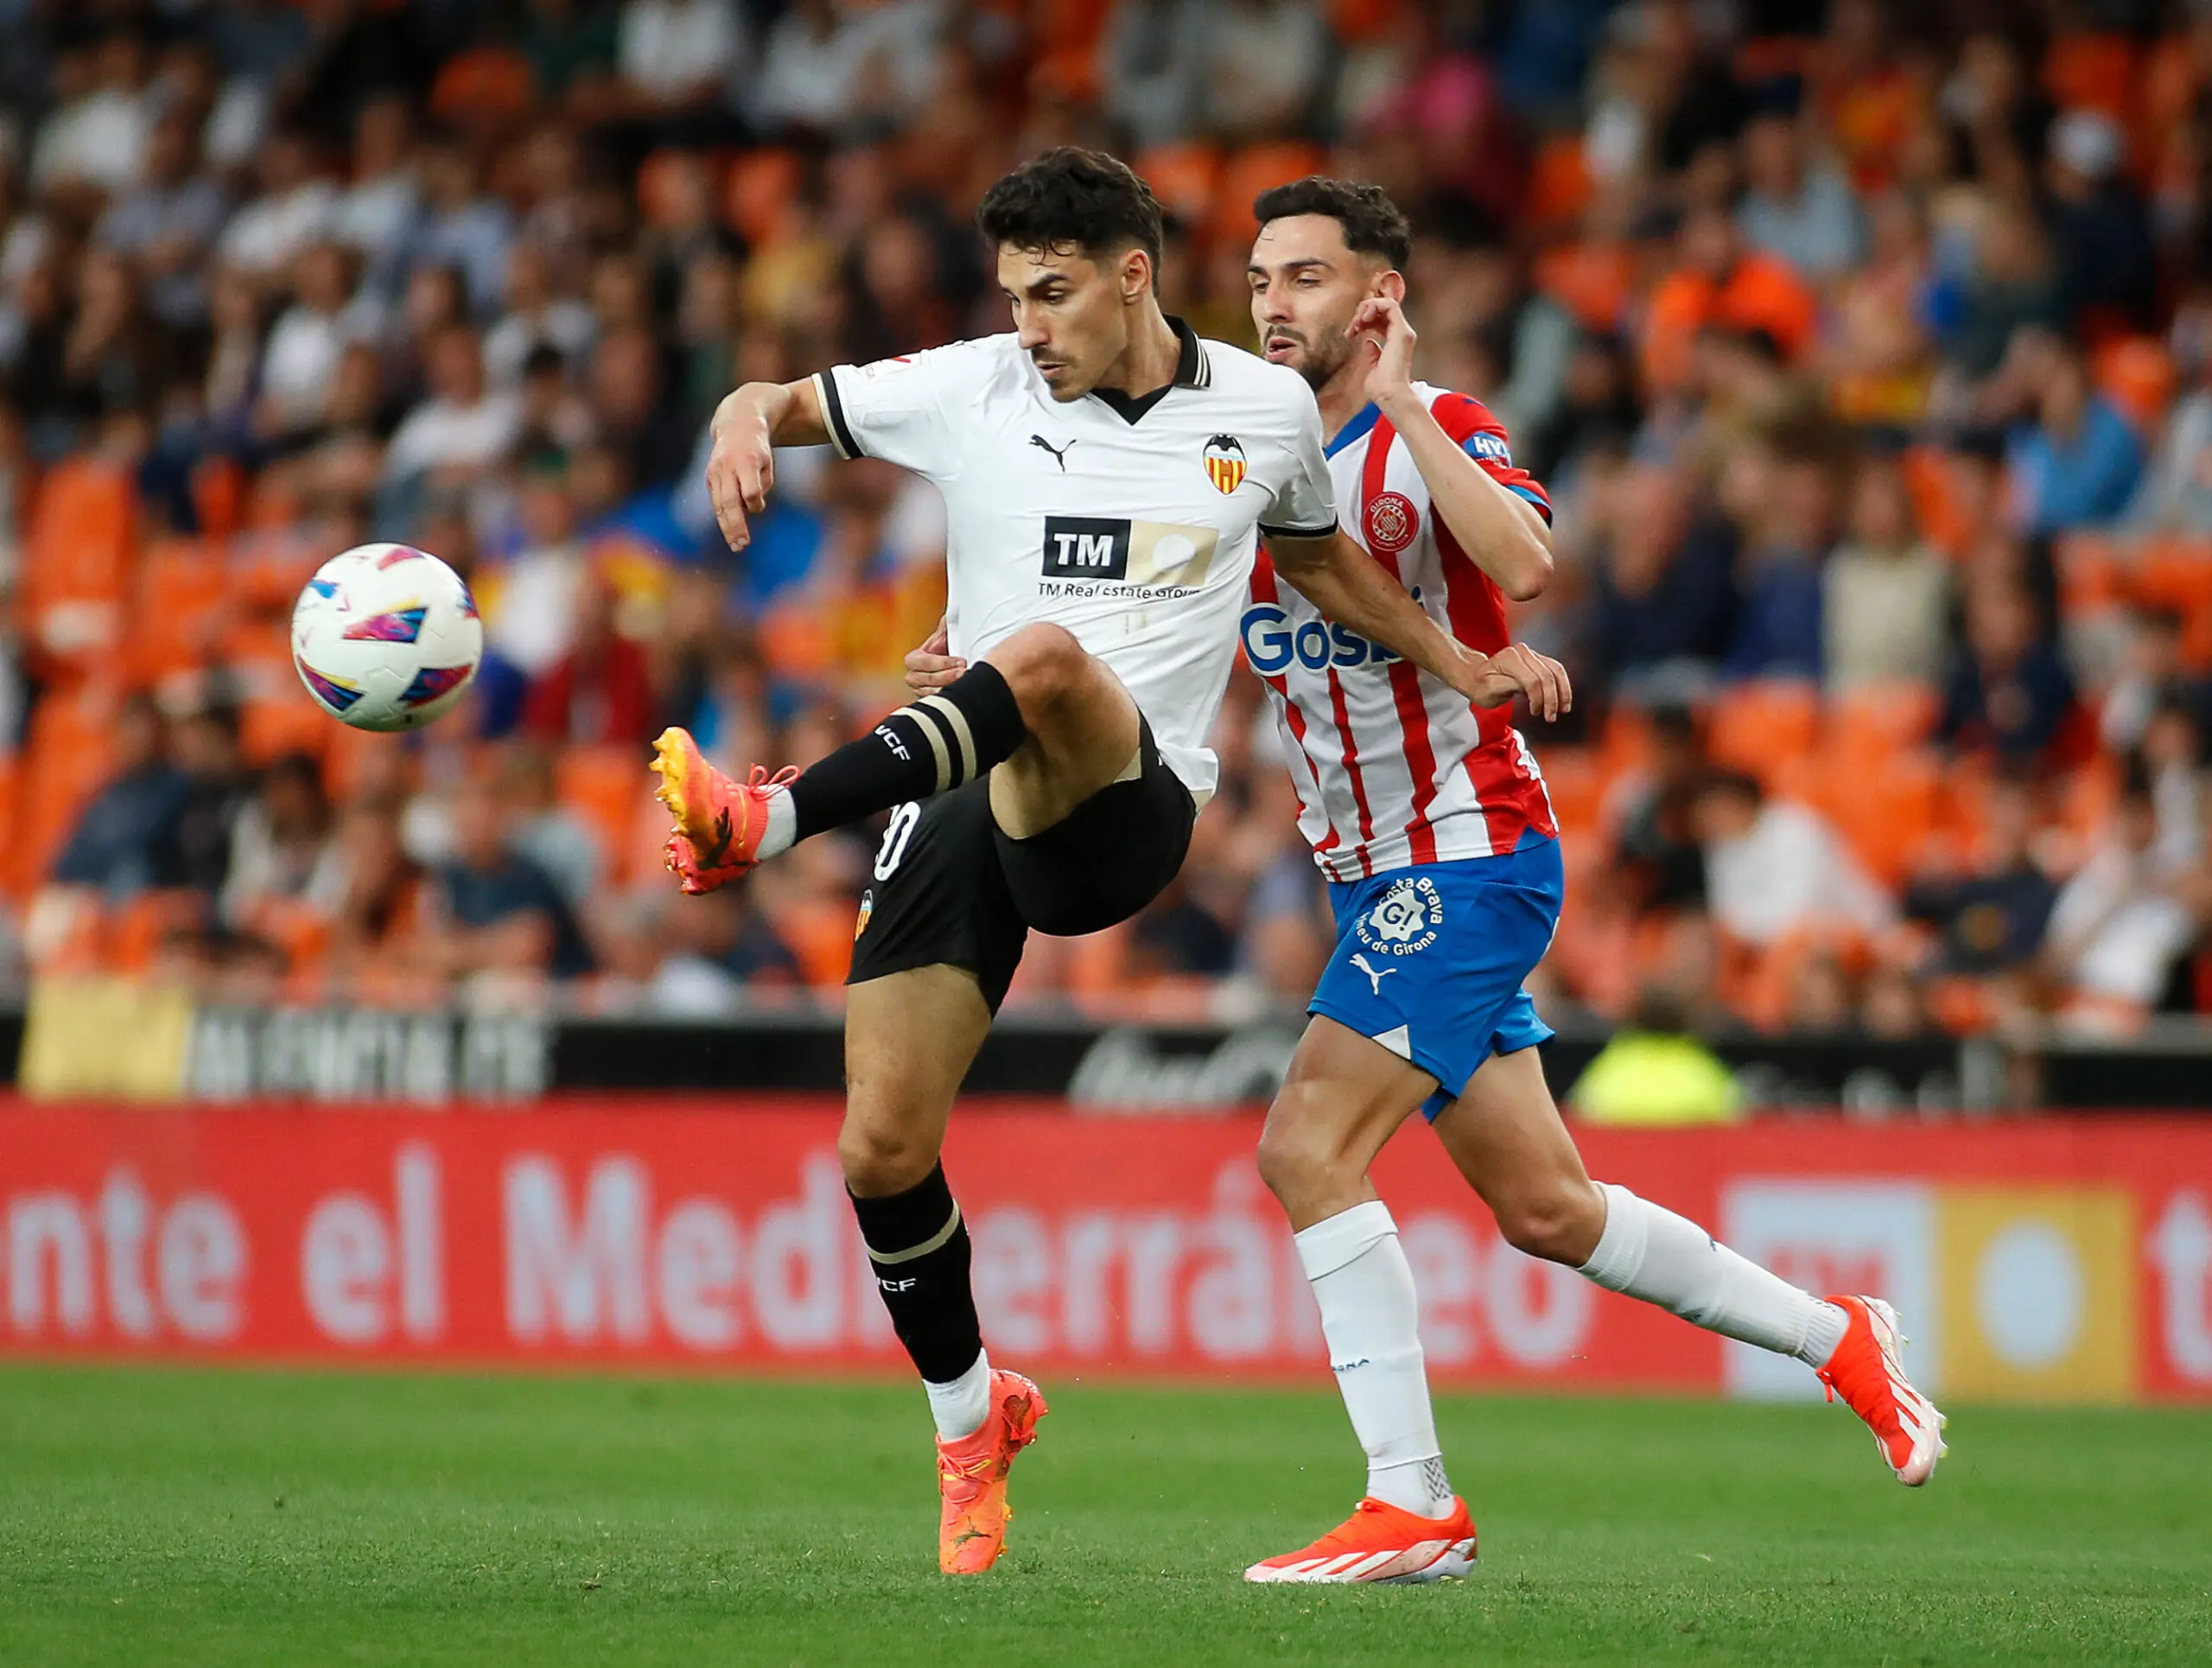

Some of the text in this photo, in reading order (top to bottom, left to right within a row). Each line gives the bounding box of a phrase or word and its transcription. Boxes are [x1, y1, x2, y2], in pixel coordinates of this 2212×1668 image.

[1370, 497, 1404, 512] GIRONA
[1053, 532, 1115, 567] TM
[1039, 583, 1060, 595] TM
[1065, 583, 1100, 597] Real
[1240, 587, 1423, 672] Gos
[874, 723, 911, 761] VCF
[874, 800, 922, 882] 0
[1415, 876, 1444, 925] Brava
[1371, 940, 1389, 955] de
[1393, 930, 1438, 957] Girona
[302, 1145, 443, 1342] el
[506, 1149, 1591, 1363] Mederráeo
[875, 1276, 917, 1292] CF
